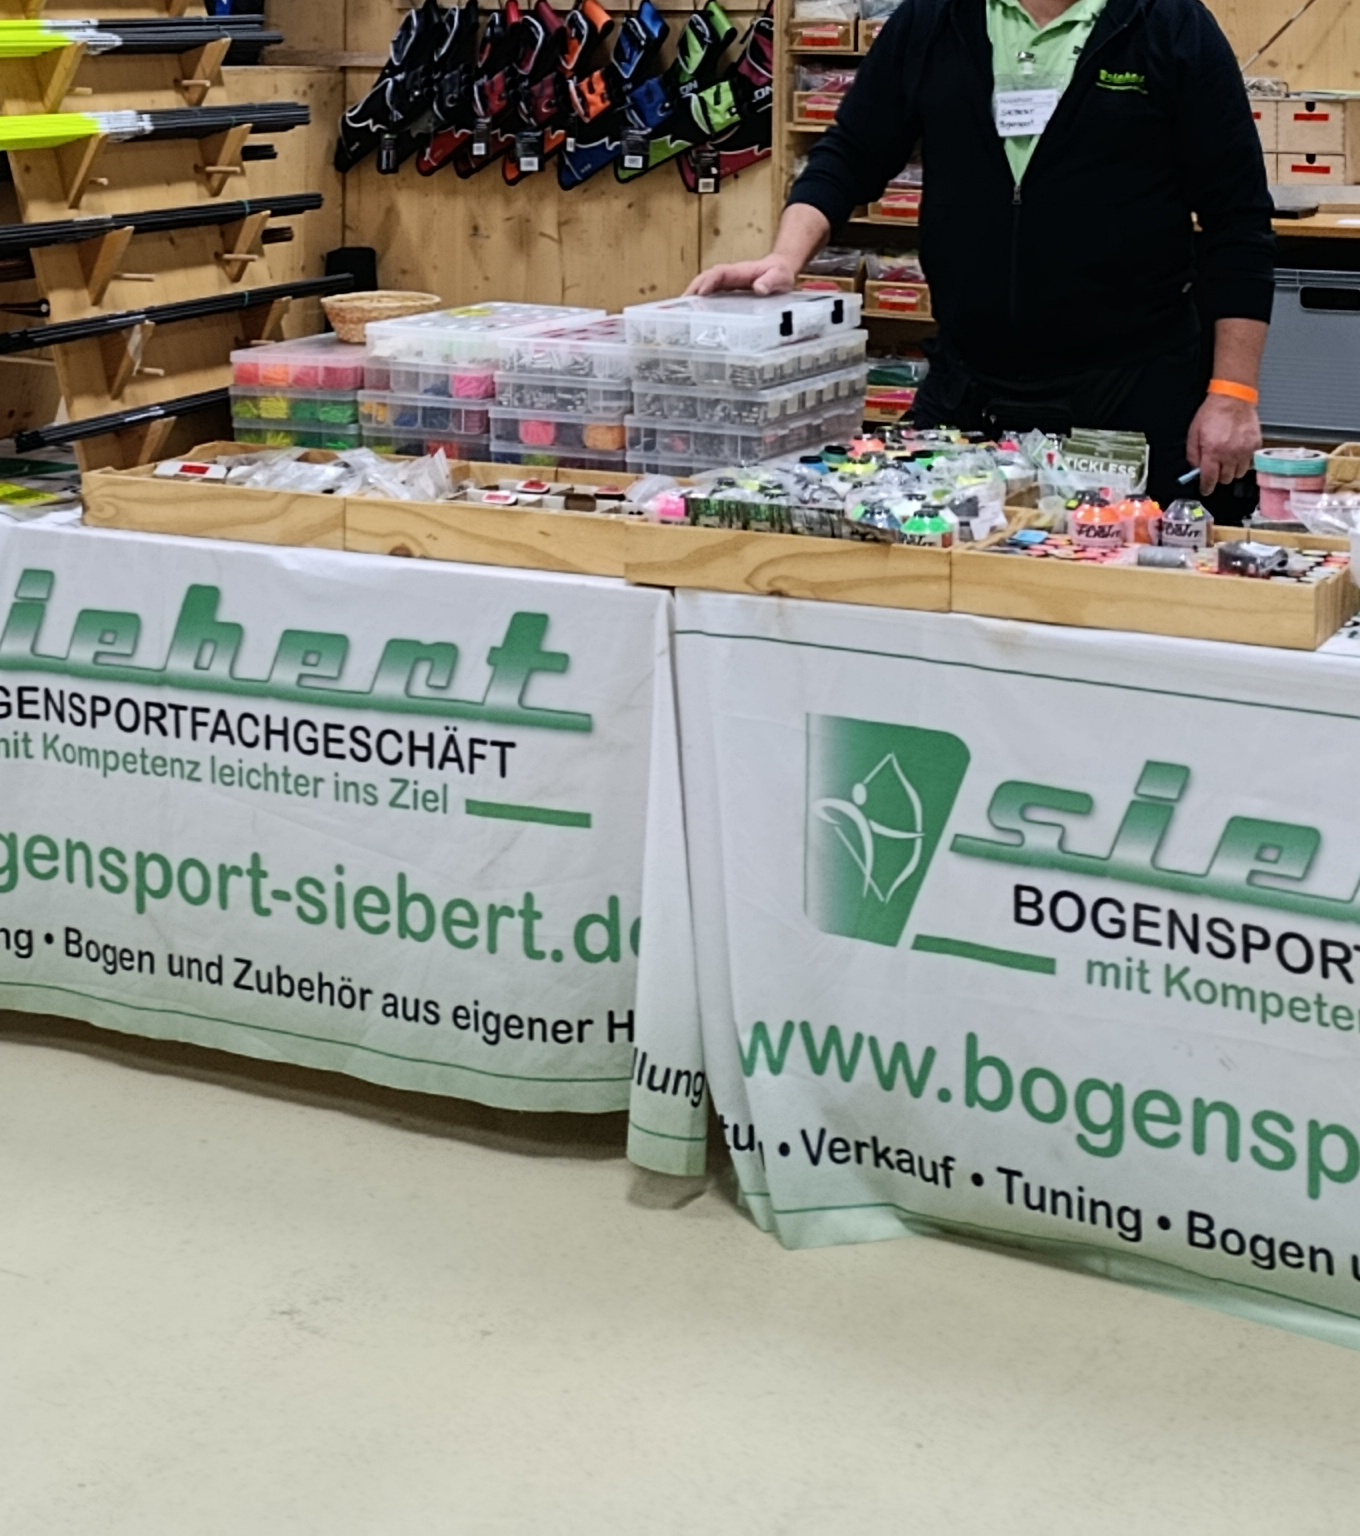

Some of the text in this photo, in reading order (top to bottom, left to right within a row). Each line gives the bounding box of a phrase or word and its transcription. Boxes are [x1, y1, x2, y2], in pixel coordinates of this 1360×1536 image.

[42, 732, 203, 783] Kompetenz
[210, 755, 325, 799] leichter
[333, 773, 379, 806] ins
[388, 777, 449, 815] Ziel
[64, 927, 155, 975] Bogen
[167, 951, 224, 987] und
[233, 958, 374, 1012] Zubehör
[381, 987, 441, 1026] aus
[452, 999, 594, 1046] eigener
[1085, 956, 1152, 995] mit
[801, 1127, 956, 1189] Verkauf
[997, 1166, 1142, 1242] Tuning
[1186, 1209, 1335, 1276] Bogen
